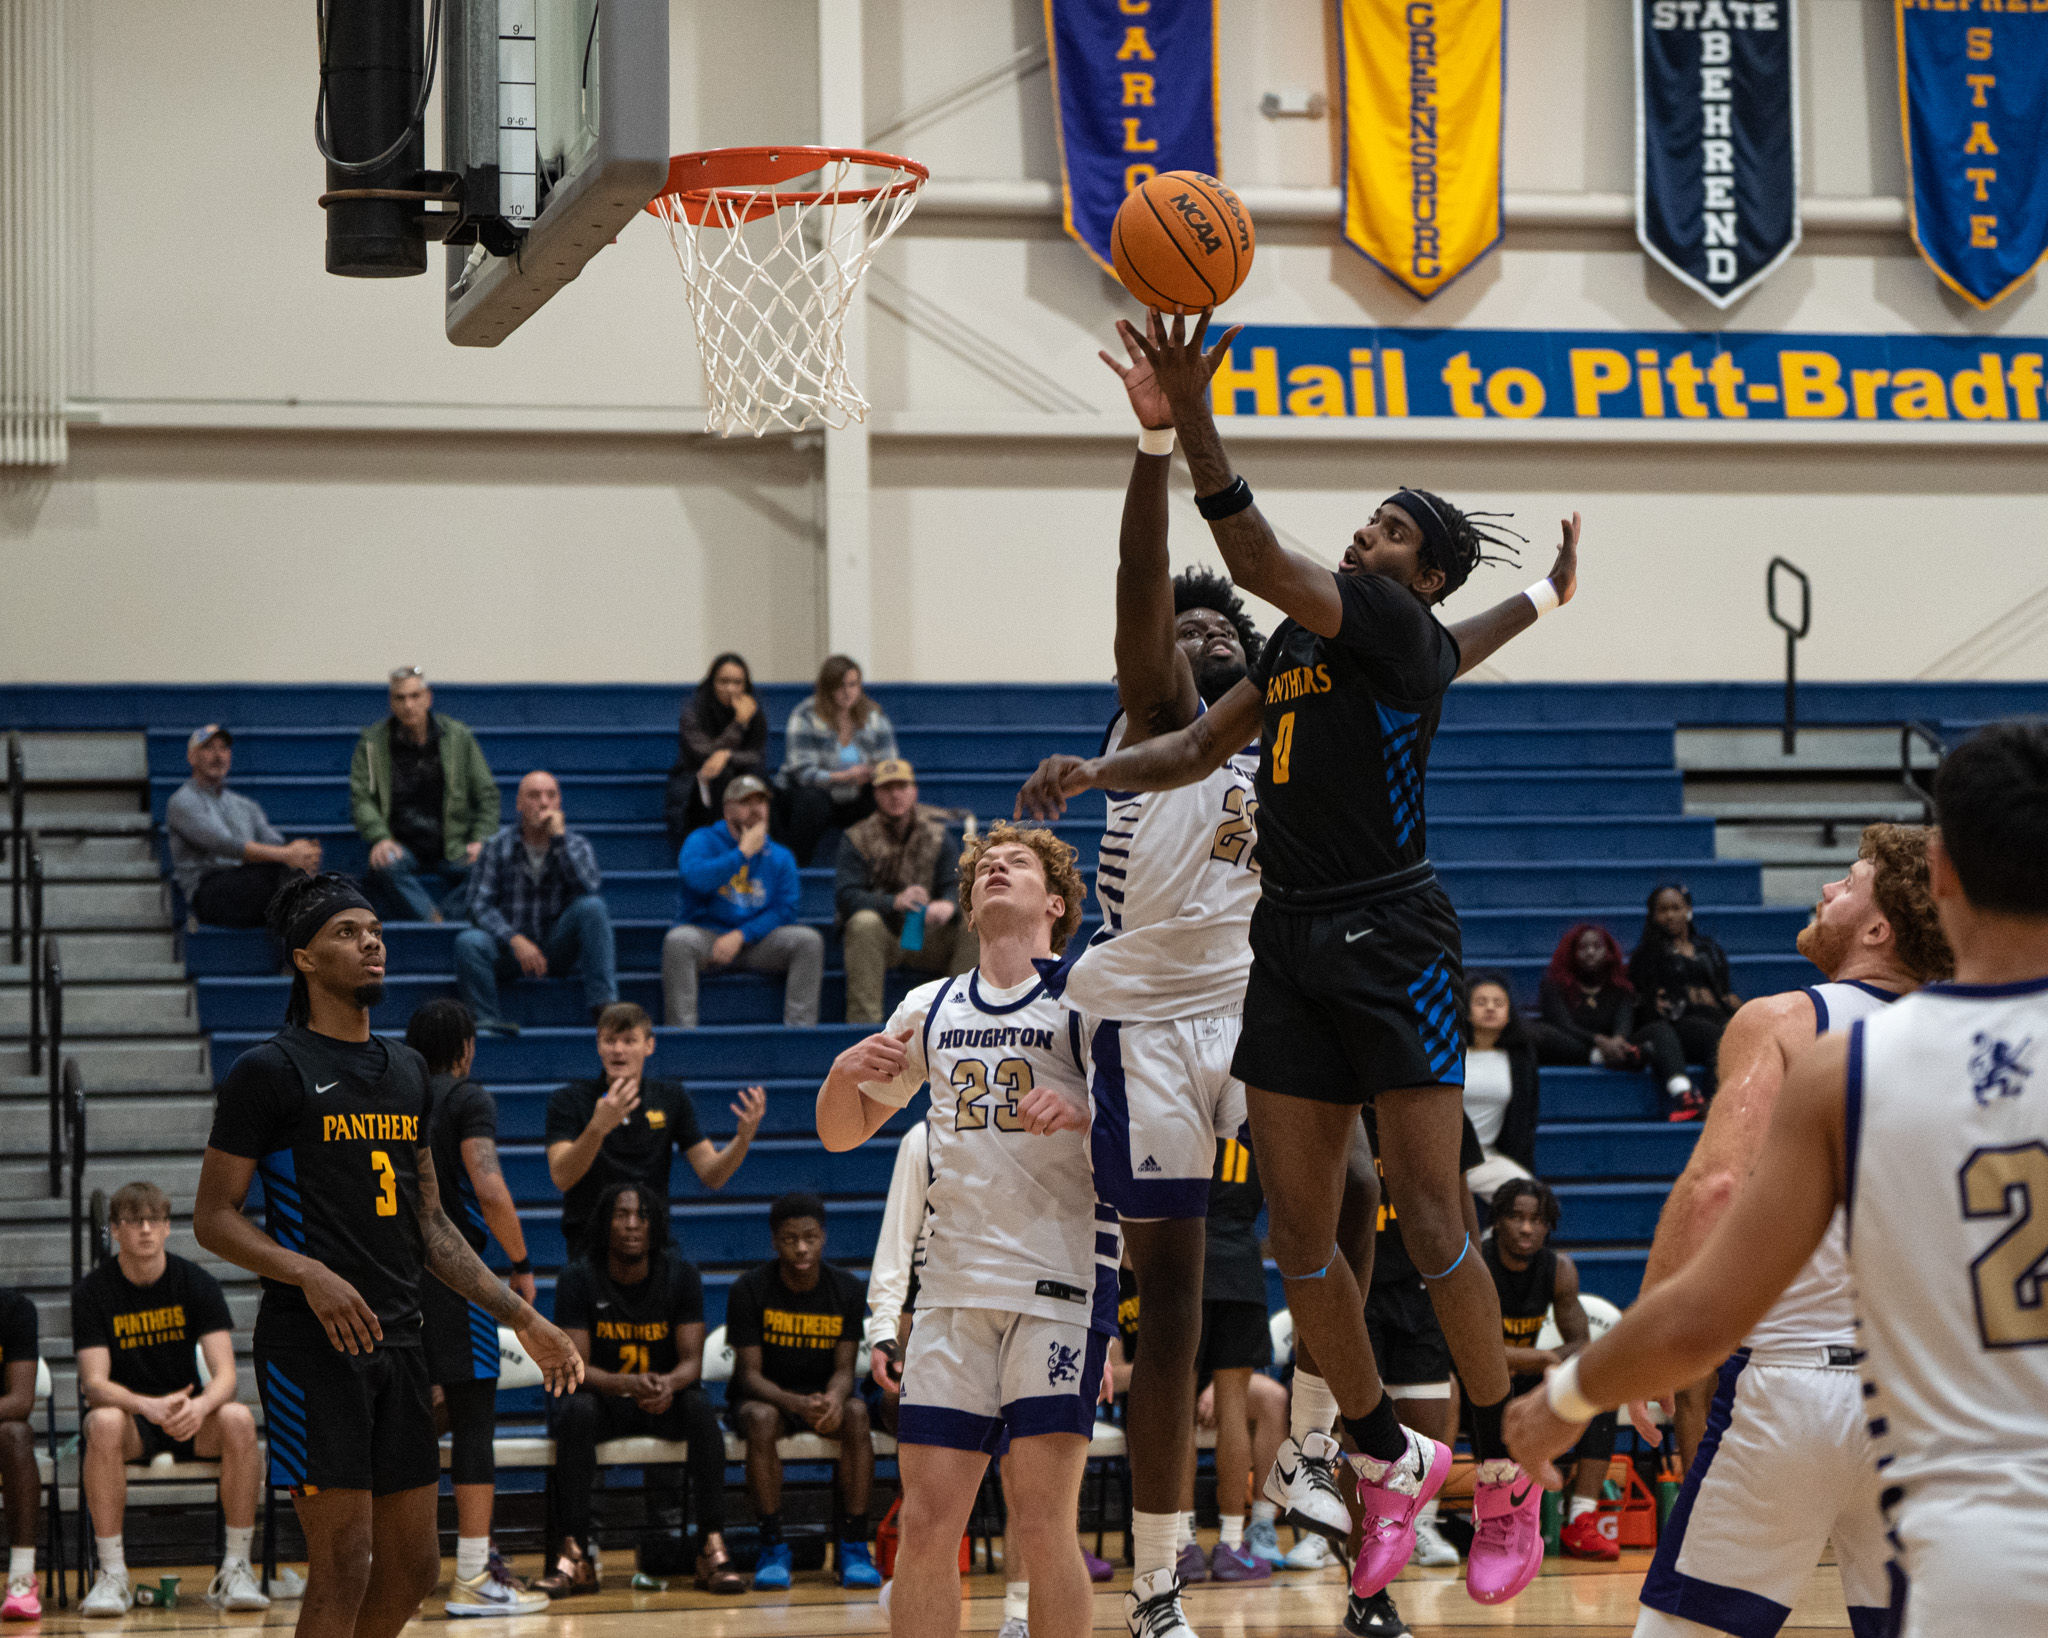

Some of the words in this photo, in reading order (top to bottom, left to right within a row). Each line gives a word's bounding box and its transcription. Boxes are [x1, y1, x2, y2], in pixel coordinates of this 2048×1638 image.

[1652, 0, 1779, 31] STATE
[1406, 2, 1442, 279] GREENSBURG
[1699, 30, 1738, 283] BEHREND
[1966, 27, 1998, 249] STATE
[1169, 192, 1223, 257] NCAA
[1195, 172, 1250, 253] Wilson
[1207, 346, 1409, 417] Hail
[1441, 351, 1547, 419] to
[1568, 347, 2048, 420] Pitt-Bradf
[936, 1026, 1055, 1051] HOUGHTON
[323, 1113, 419, 1142] PANTHERS
[951, 1057, 1035, 1132] 23
[371, 1150, 398, 1217] 3
[596, 1321, 668, 1342] PANTHERS
[763, 1307, 844, 1337] PANTHERS
